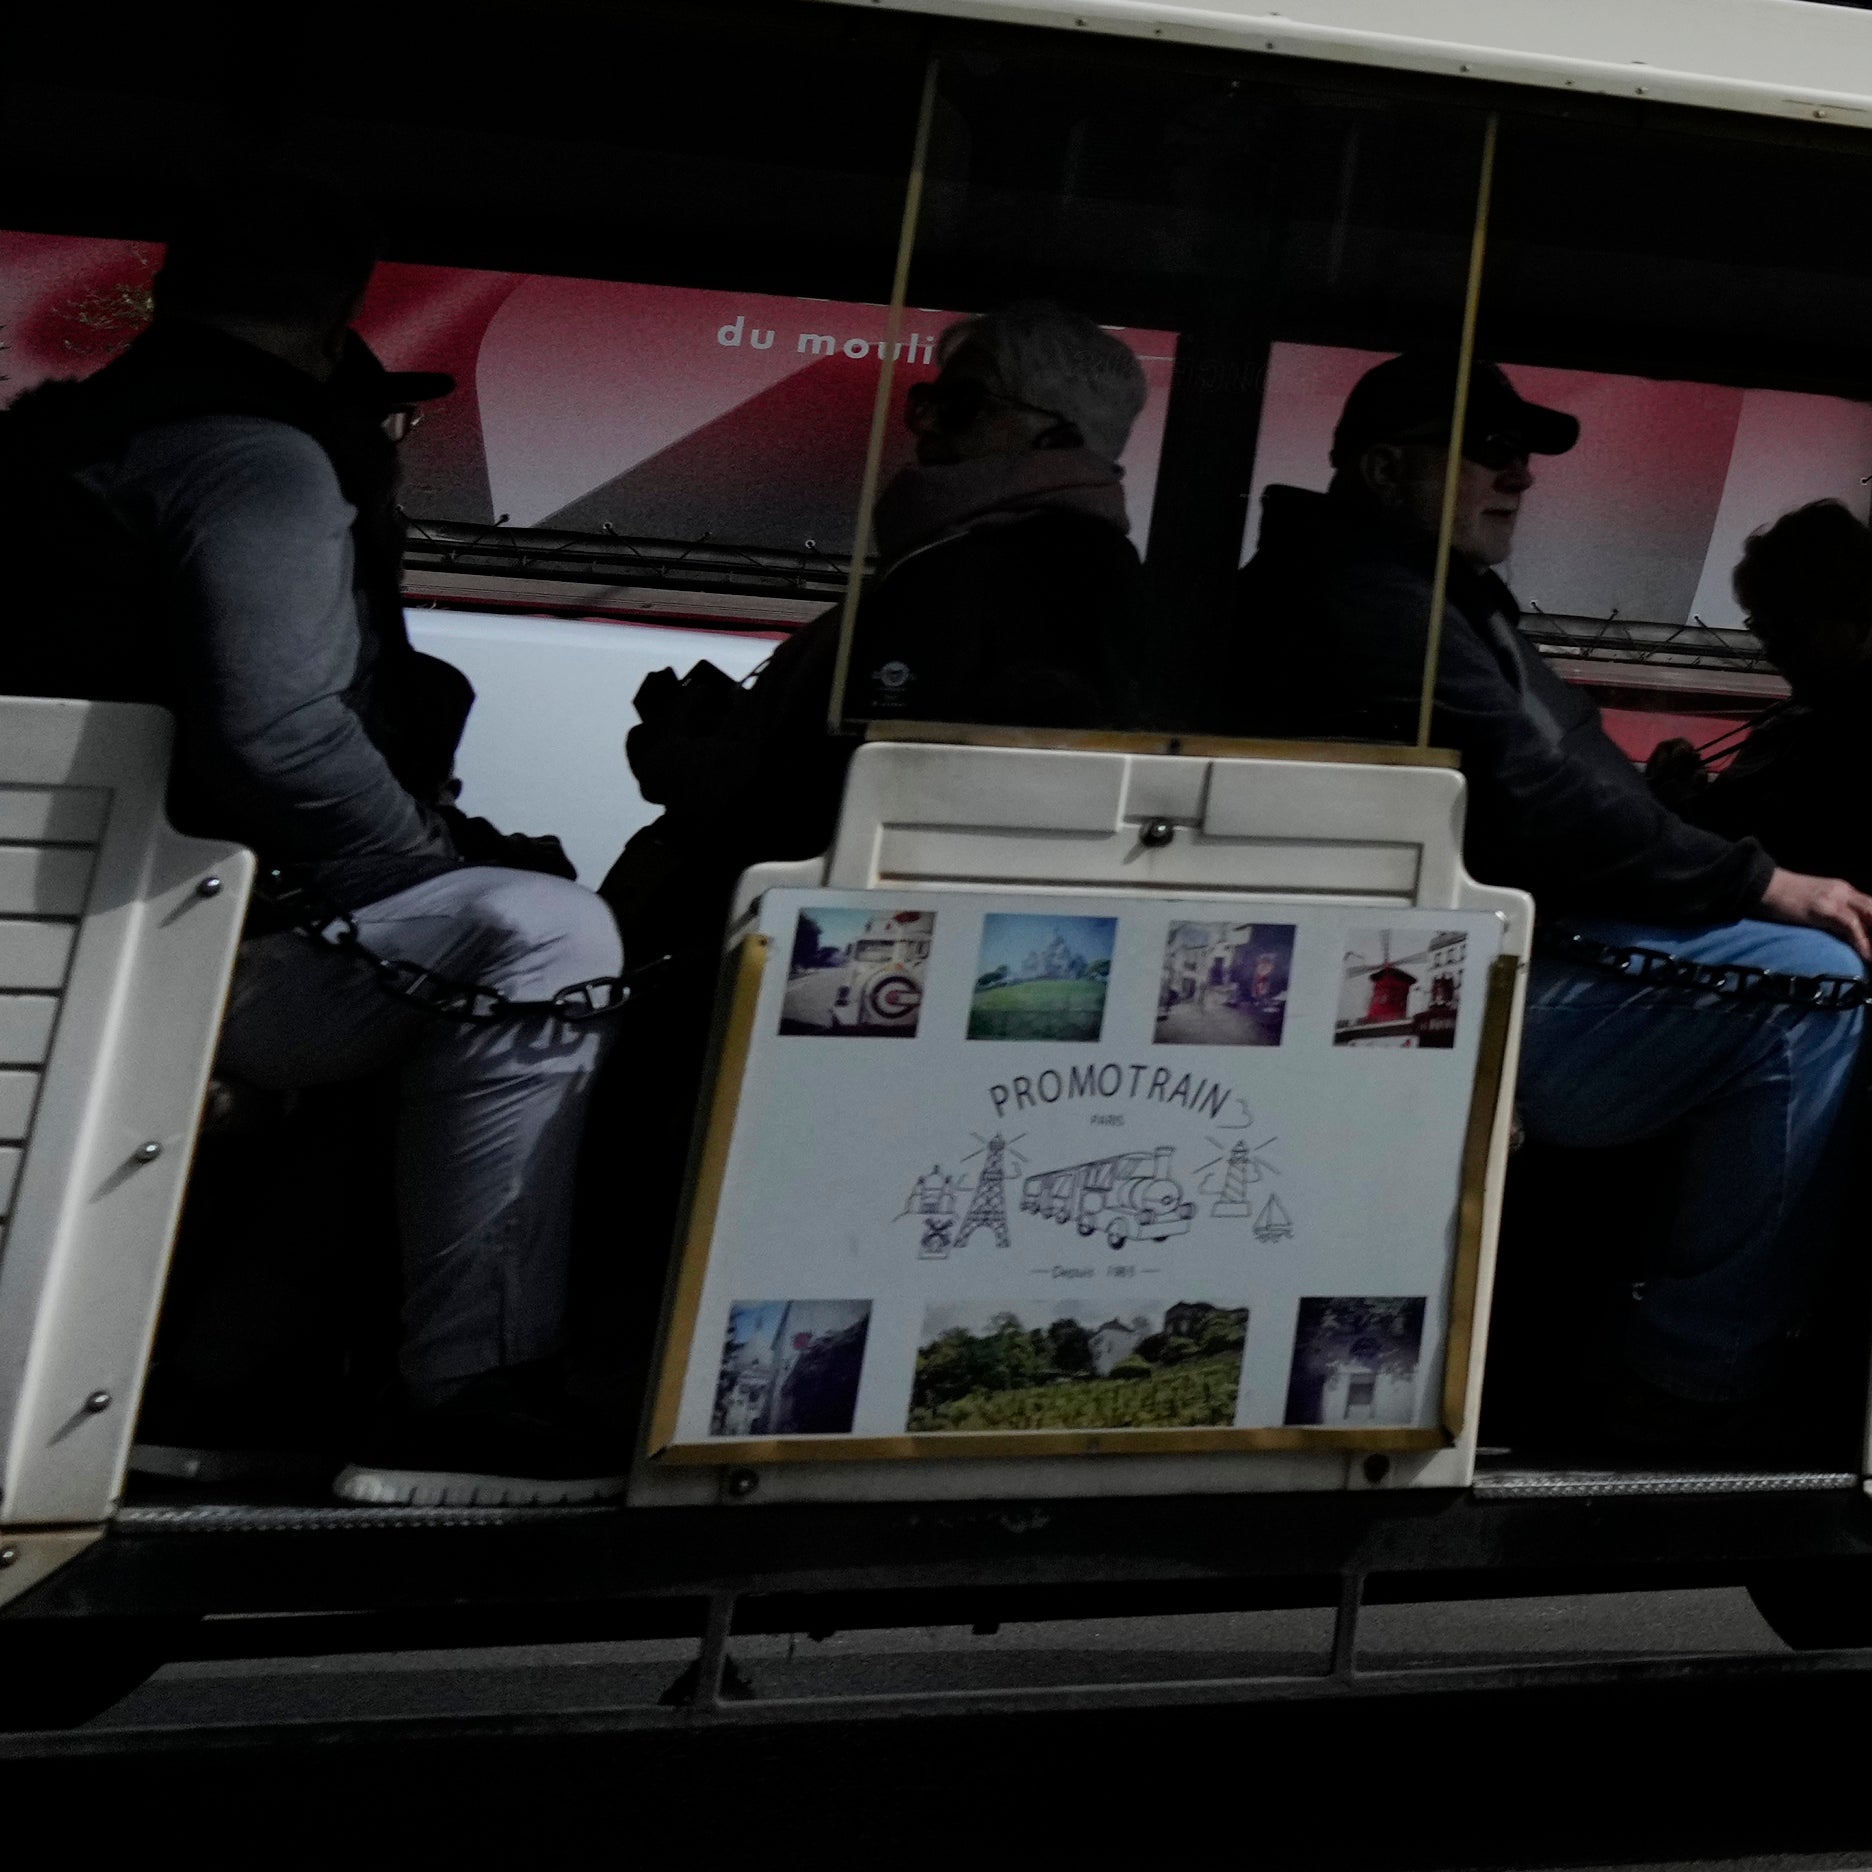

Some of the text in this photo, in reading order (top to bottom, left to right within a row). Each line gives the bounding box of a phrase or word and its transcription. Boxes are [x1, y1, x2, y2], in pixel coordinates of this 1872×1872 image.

[716, 315, 937, 365] du mouli
[989, 1064, 1231, 1118] PROMOTRAIN
